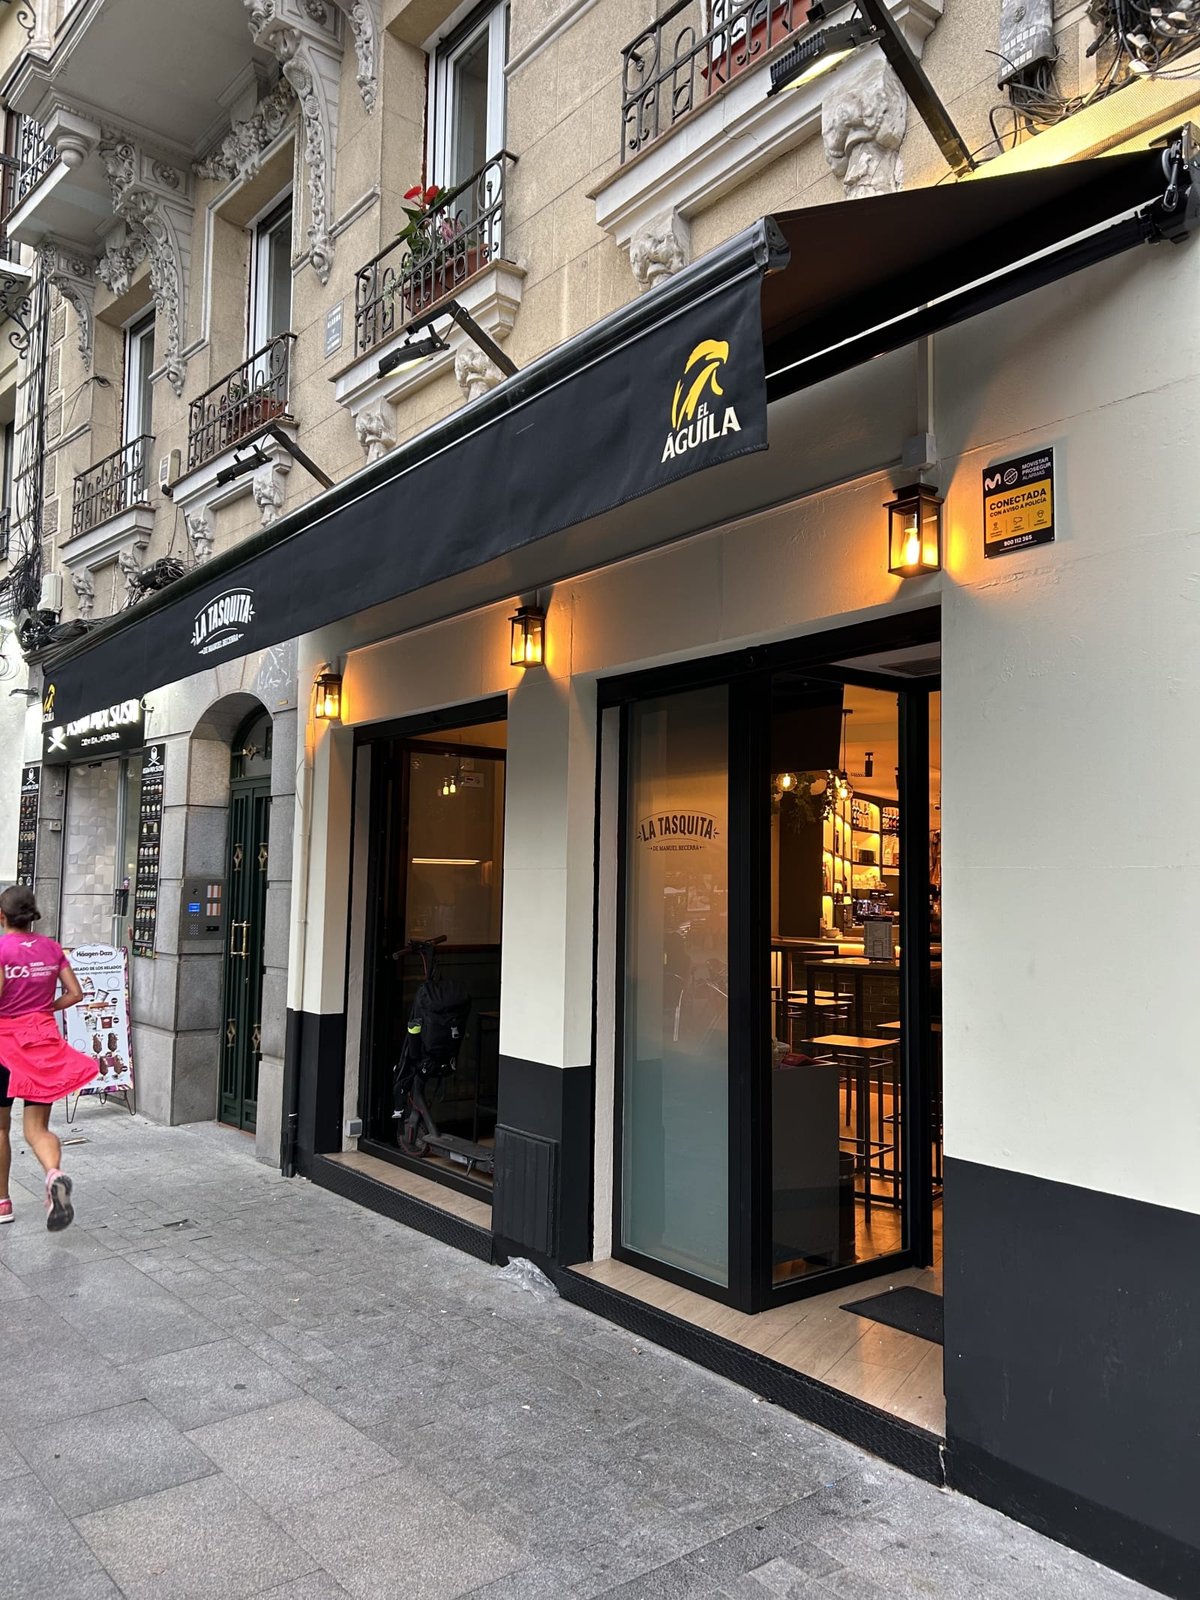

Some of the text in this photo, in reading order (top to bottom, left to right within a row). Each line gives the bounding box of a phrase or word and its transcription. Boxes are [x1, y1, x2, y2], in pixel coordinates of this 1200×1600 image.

[697, 402, 709, 419] EL
[661, 406, 741, 463] ÁGUILA
[1021, 456, 1049, 469] MOVISTAR
[1021, 462, 1052, 476] PROSEGUR
[1022, 469, 1046, 480] ALARMAS
[989, 488, 1046, 510] CONECTADA
[989, 510, 1002, 518] CON
[1002, 505, 1019, 514] AVISO
[1025, 497, 1046, 508] POLICÍA
[195, 613, 207, 645] LA
[208, 594, 250, 632] TASQUITA
[641, 815, 713, 842] LA TASQUITA
[76, 950, 113, 958] Häagen-Dazs
